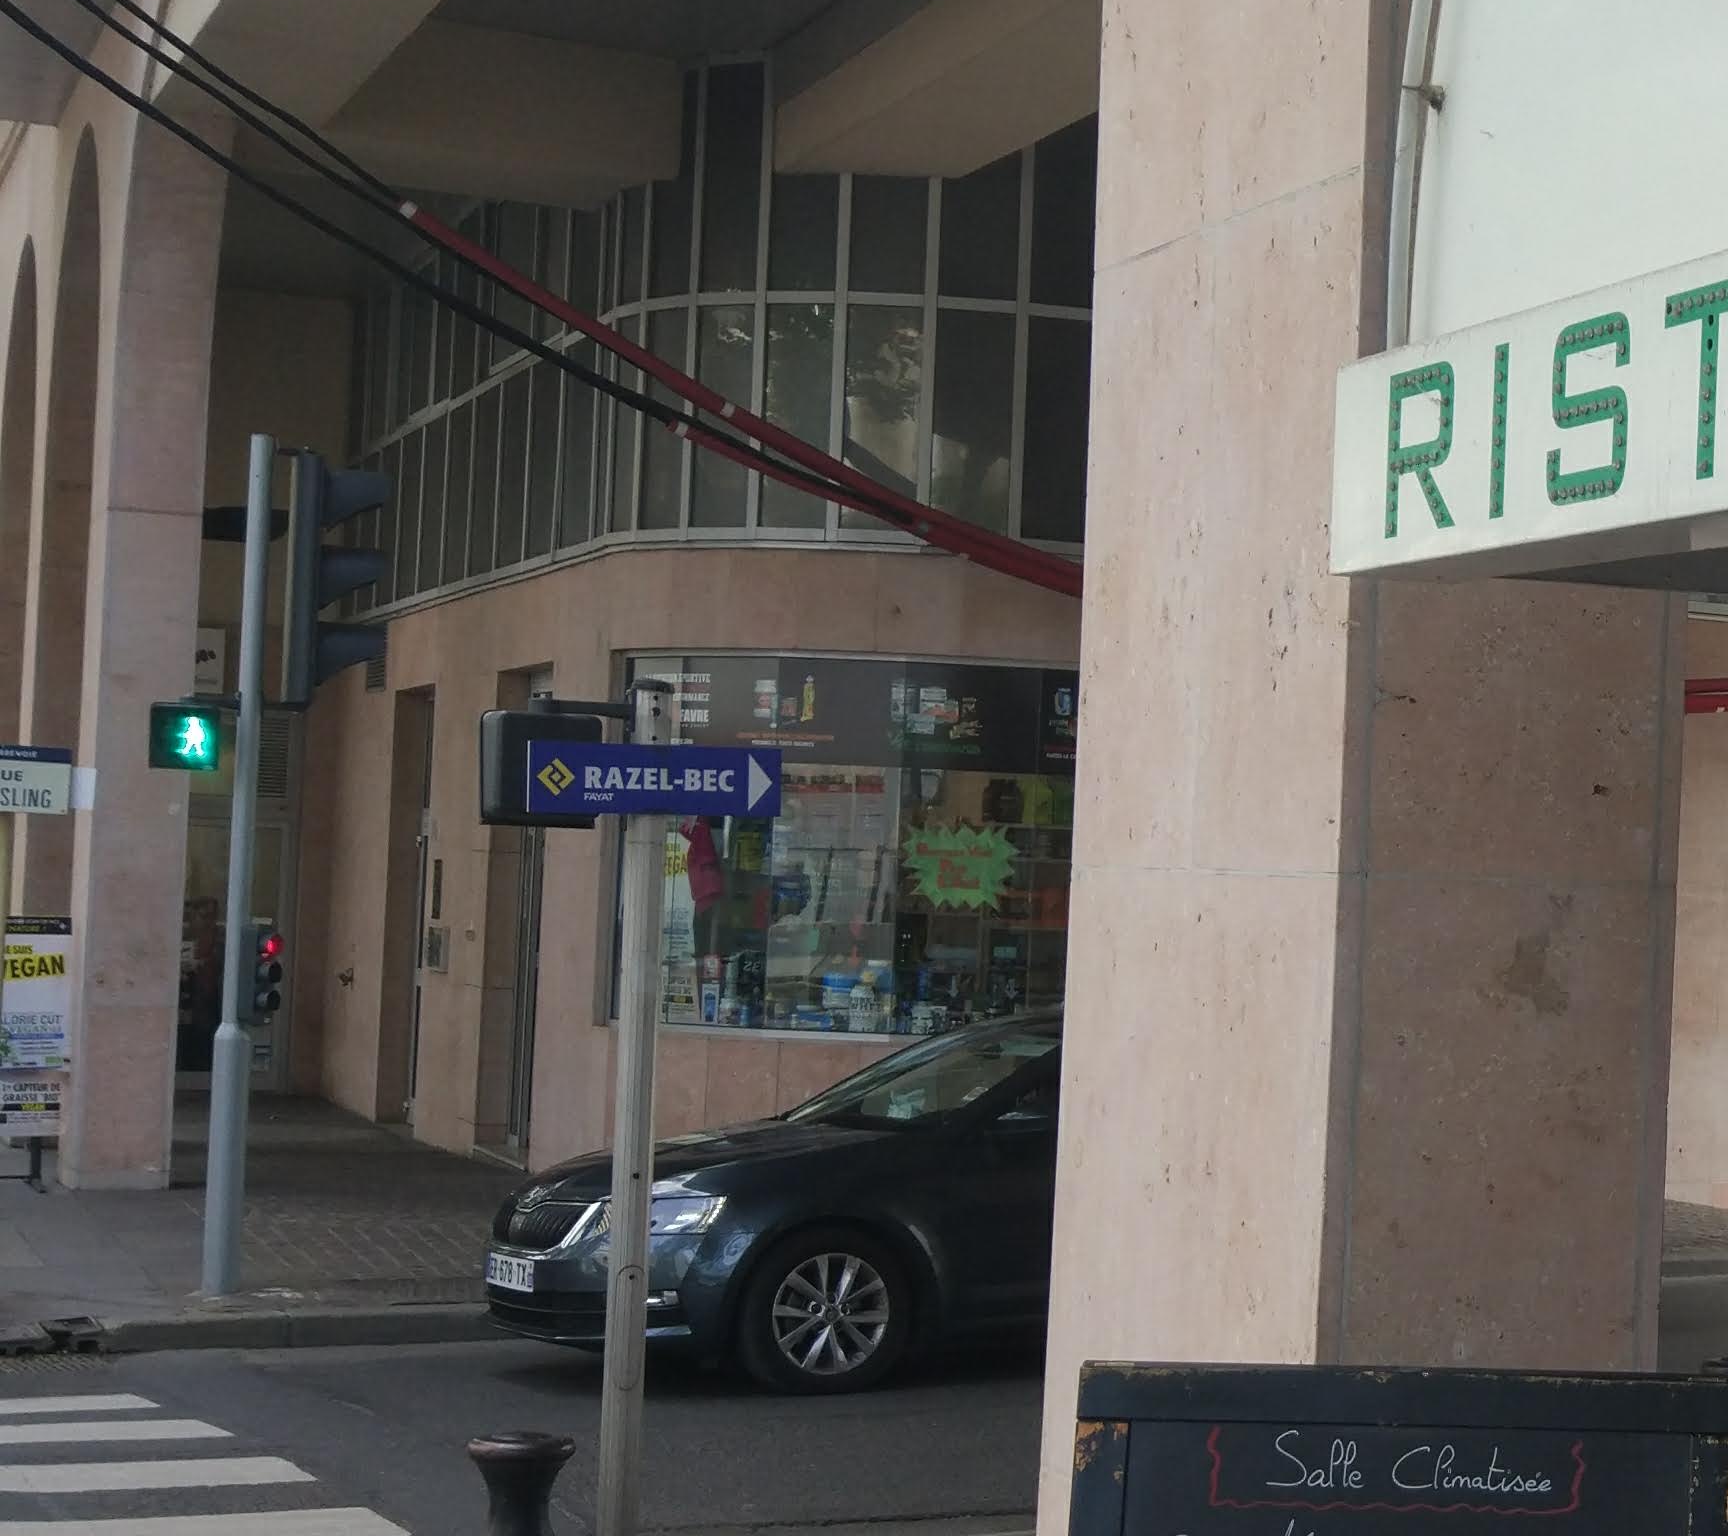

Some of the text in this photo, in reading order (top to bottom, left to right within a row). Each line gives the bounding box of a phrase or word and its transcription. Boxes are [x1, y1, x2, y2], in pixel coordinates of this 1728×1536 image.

[584, 765, 735, 793] RAZEL-BEC
[584, 793, 614, 802] FAYAT
[1266, 1429, 1553, 1494] Salle Climatisée
